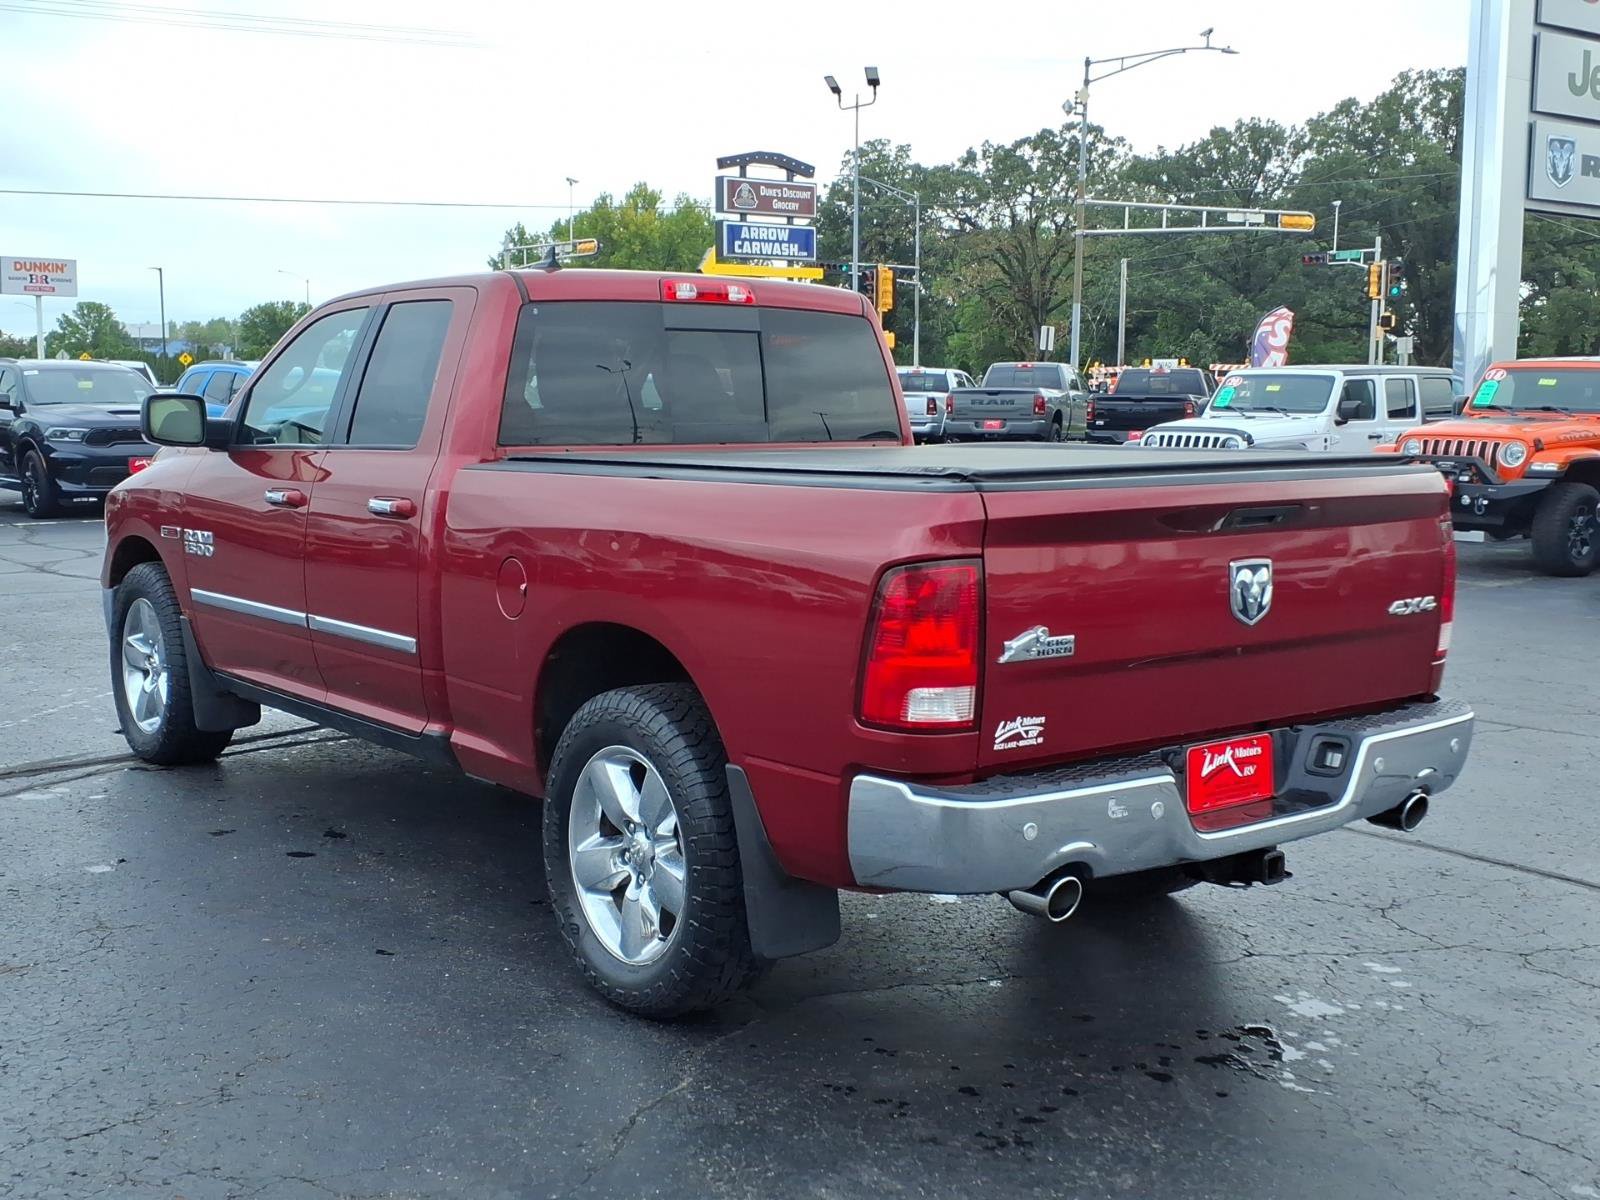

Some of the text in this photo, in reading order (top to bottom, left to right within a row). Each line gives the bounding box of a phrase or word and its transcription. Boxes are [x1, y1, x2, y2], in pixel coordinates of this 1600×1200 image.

[760, 185, 812, 199] DUKE'S DISCOUNT
[772, 199, 799, 210] GROCERY
[741, 226, 789, 241] ARROW
[14, 261, 67, 273] DUNKIN'
[183, 528, 213, 544] RAM
[184, 541, 214, 557] 1500
[1046, 638, 1072, 648] BIG
[1037, 646, 1073, 657] HORN
[994, 716, 1028, 738] Link
[1201, 744, 1263, 778] Link Motors
[1243, 764, 1257, 777] RV
